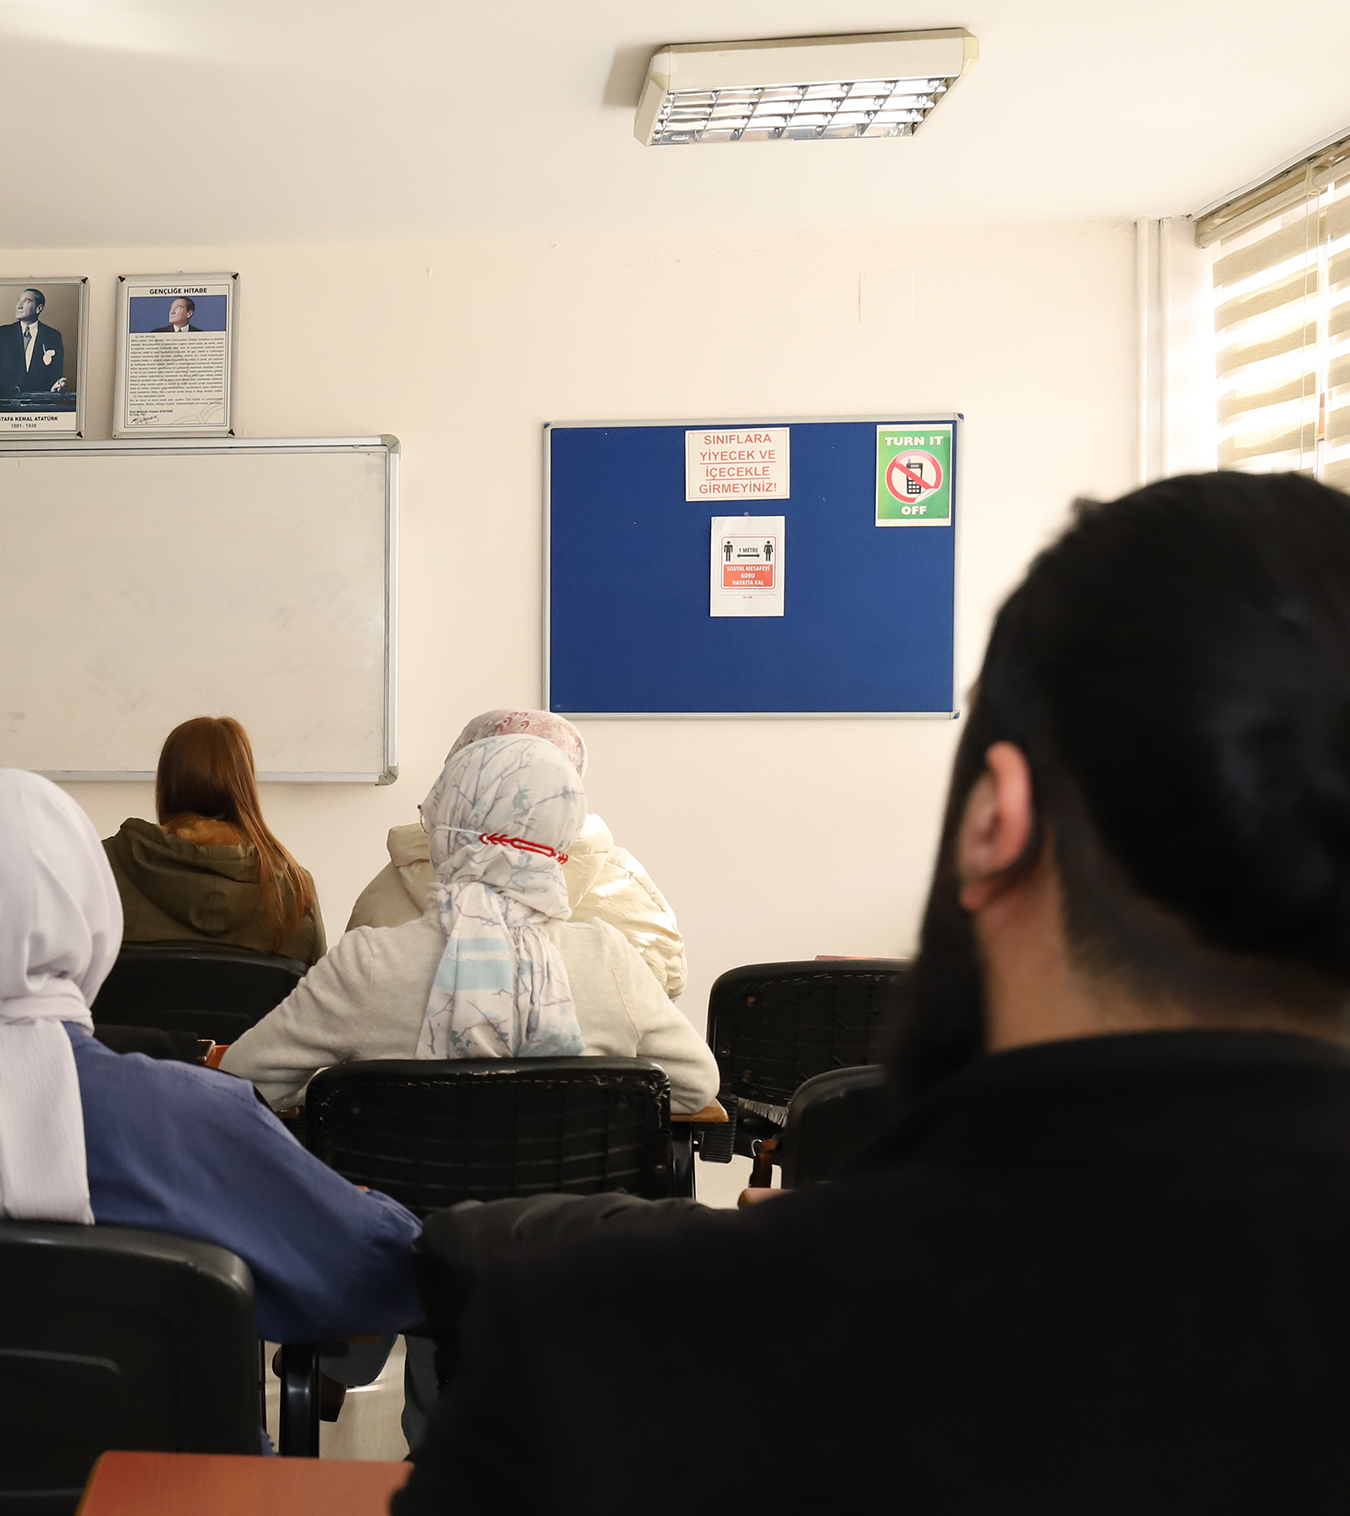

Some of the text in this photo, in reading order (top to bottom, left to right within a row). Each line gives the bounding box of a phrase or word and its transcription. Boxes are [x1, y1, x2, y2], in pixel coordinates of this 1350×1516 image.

[704, 434, 772, 445] SINIFLARA
[885, 435, 944, 446] TURN IT
[700, 450, 776, 461] YİYECEK VE
[705, 465, 770, 478] İÇECEKLE
[699, 482, 777, 494] GİRMEYİNİZ!
[901, 506, 927, 516] OFF
